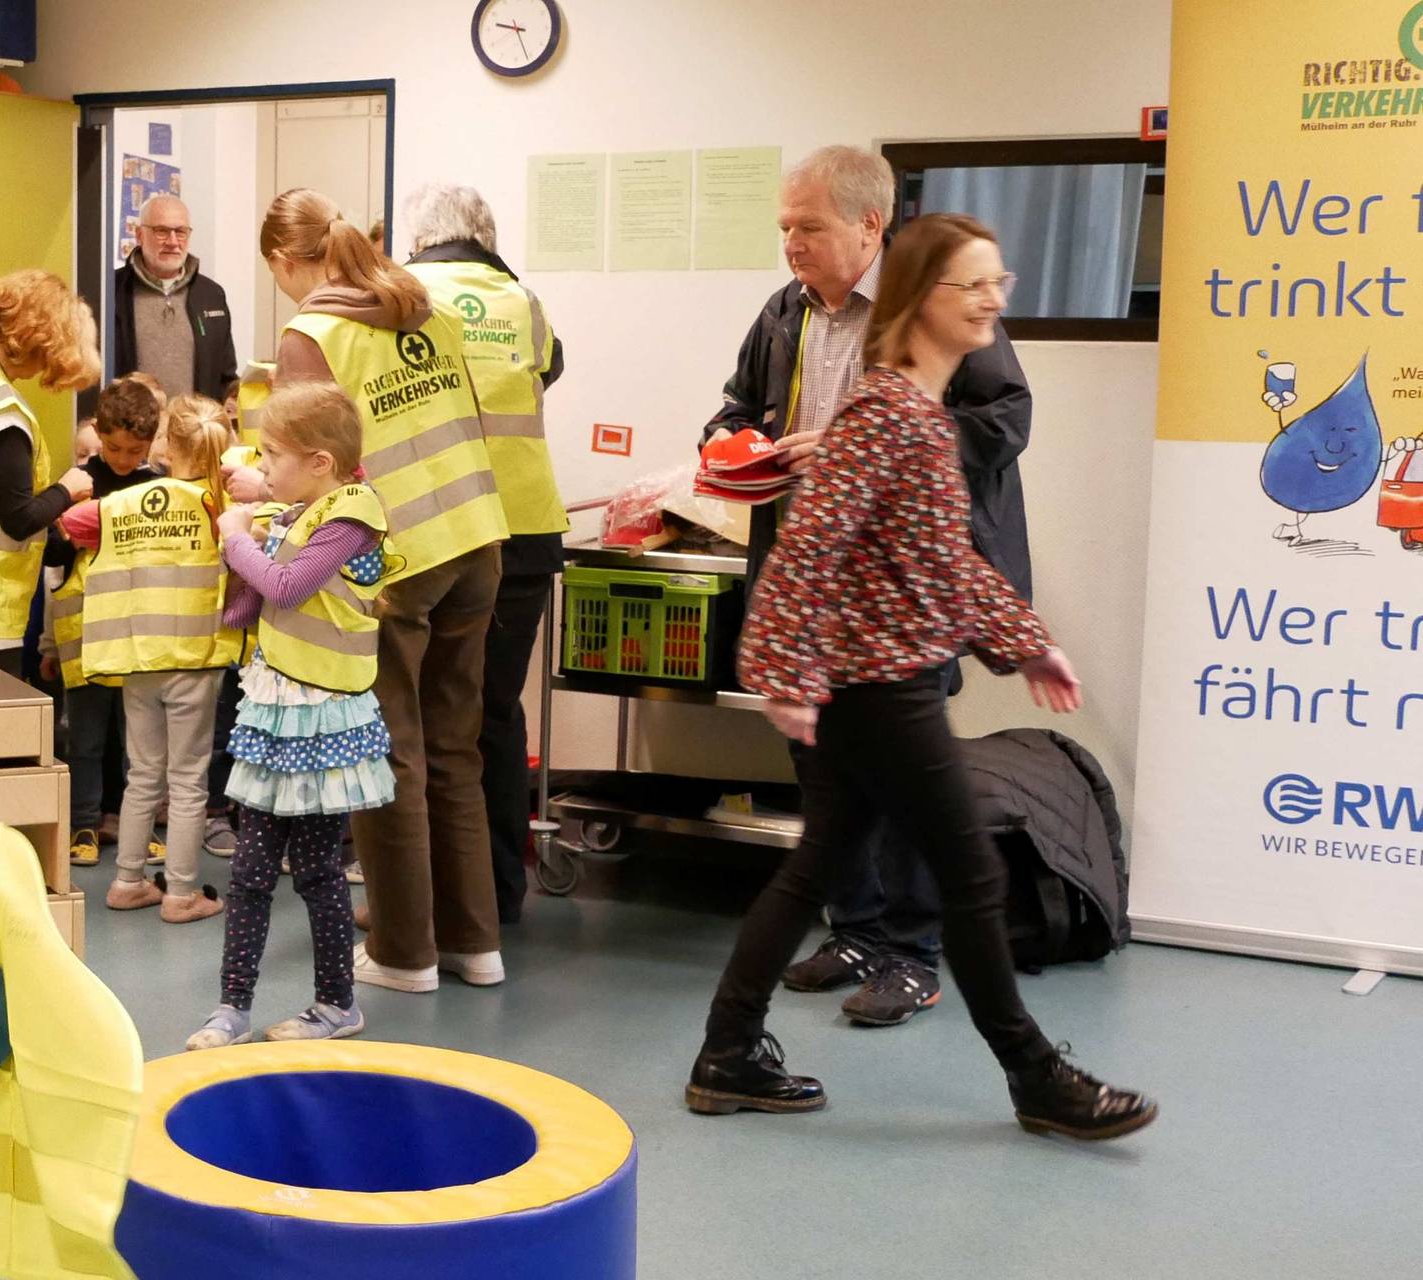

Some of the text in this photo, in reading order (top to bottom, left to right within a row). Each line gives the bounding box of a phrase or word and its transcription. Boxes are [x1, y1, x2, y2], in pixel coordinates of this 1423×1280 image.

[1303, 58, 1421, 86] RICHTIG.
[1300, 118, 1417, 131] Mülheim an der Ruhr
[1237, 178, 1384, 237] Wer
[1204, 260, 1407, 318] trinkt
[1207, 586, 1347, 645] Wer
[1194, 664, 1369, 728] fährt
[1261, 834, 1423, 866] WIR BEWEGE
